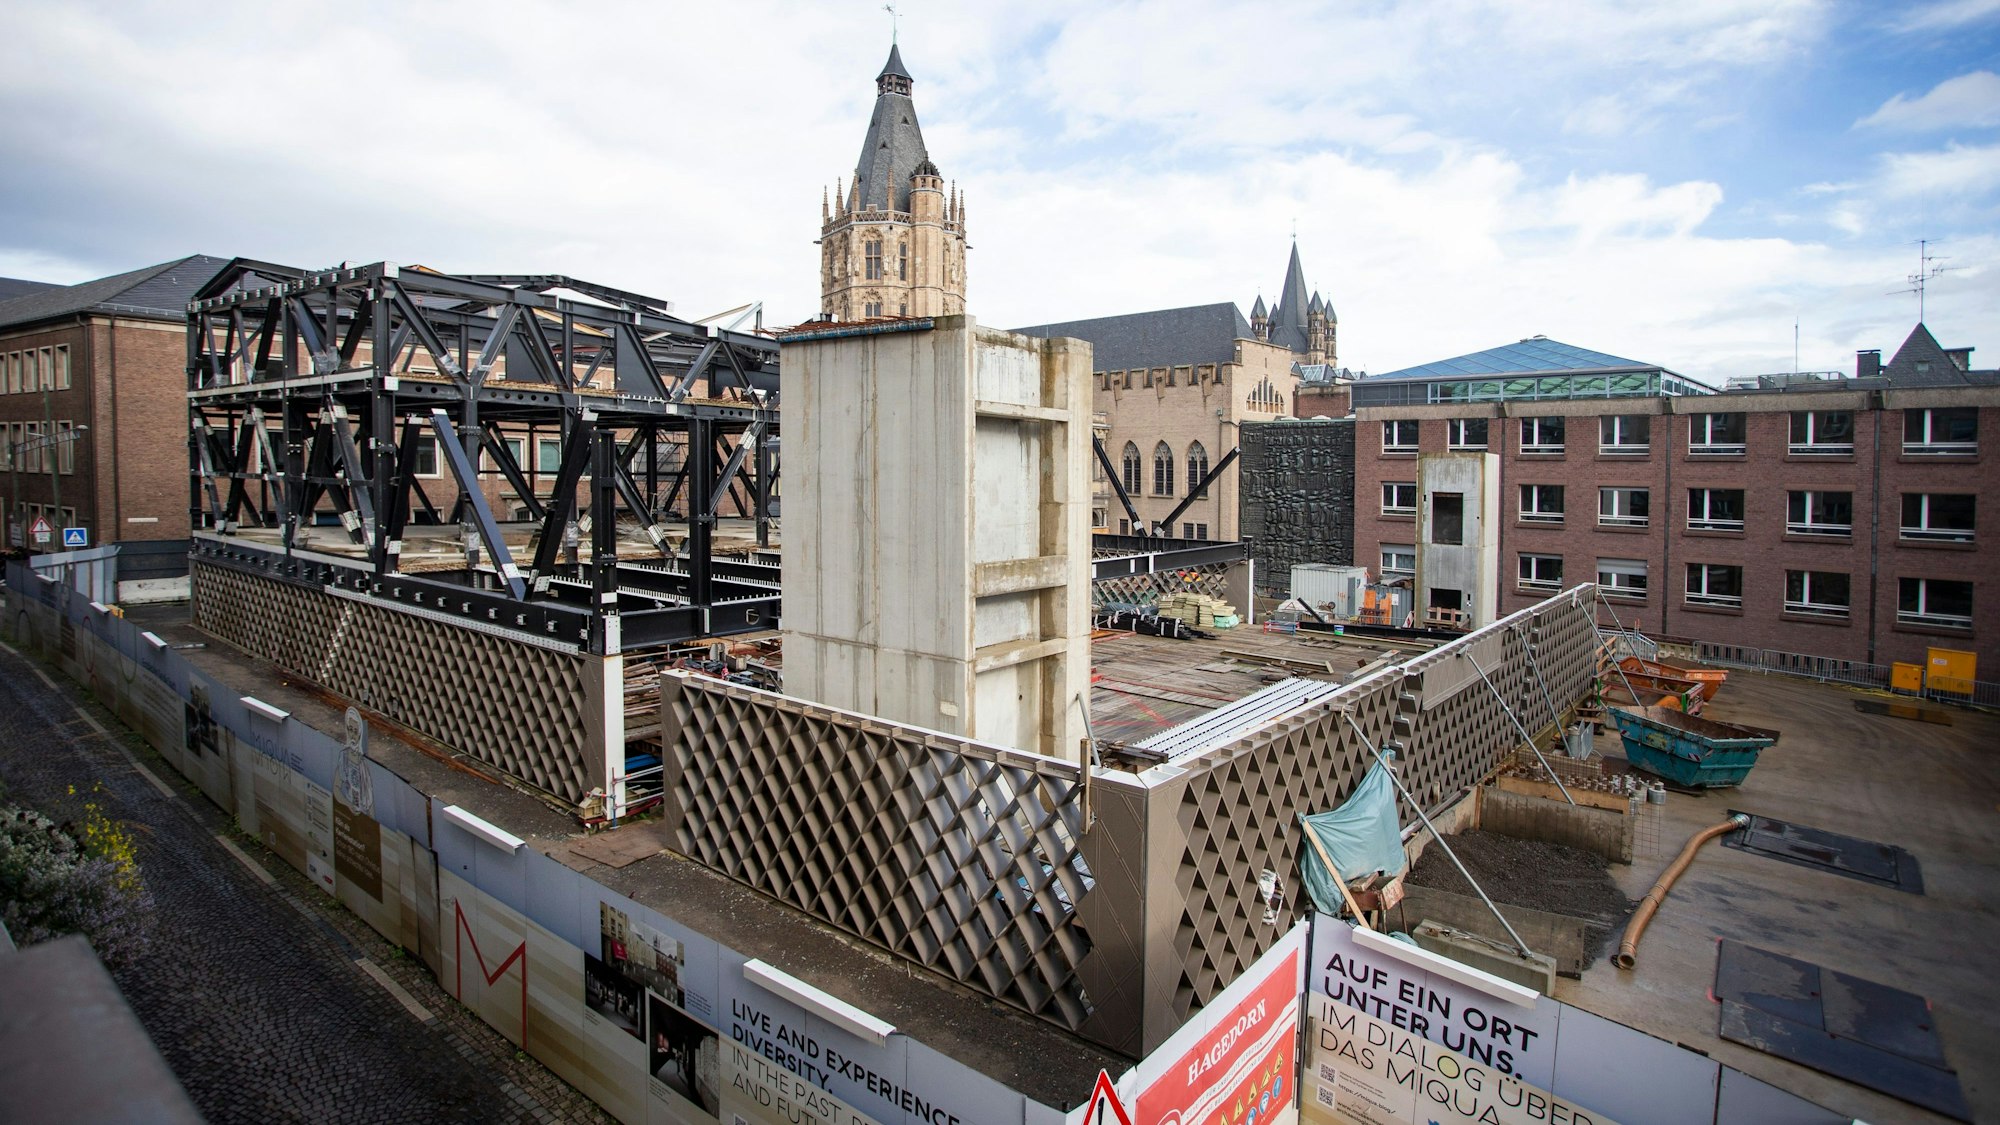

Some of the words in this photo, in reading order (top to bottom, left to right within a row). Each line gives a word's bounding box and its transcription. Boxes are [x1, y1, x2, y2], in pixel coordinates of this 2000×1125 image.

[732, 998, 771, 1034] LIVE
[776, 1024, 820, 1060] AND
[1187, 998, 1266, 1087] HAGEDORN
[1324, 976, 1429, 1040] UNTER
[1442, 1025, 1523, 1080] UNS.
[1325, 953, 1388, 990] AUF
[1399, 978, 1451, 1019] EIN
[1463, 1007, 1539, 1052] ORT
[732, 1022, 834, 1095] DIVERSITY.
[732, 1046, 750, 1072] IN
[754, 1057, 789, 1095] THE
[796, 1082, 842, 1124] PAST
[1320, 1028, 1374, 1070] DAS
[1386, 1059, 1500, 1125] MIQUA
[1322, 1002, 1356, 1035] IM
[1368, 1022, 1486, 1091] DIALOG
[733, 1073, 771, 1107] AND
[1338, 1083, 1396, 1114] https://miqua.blog/
